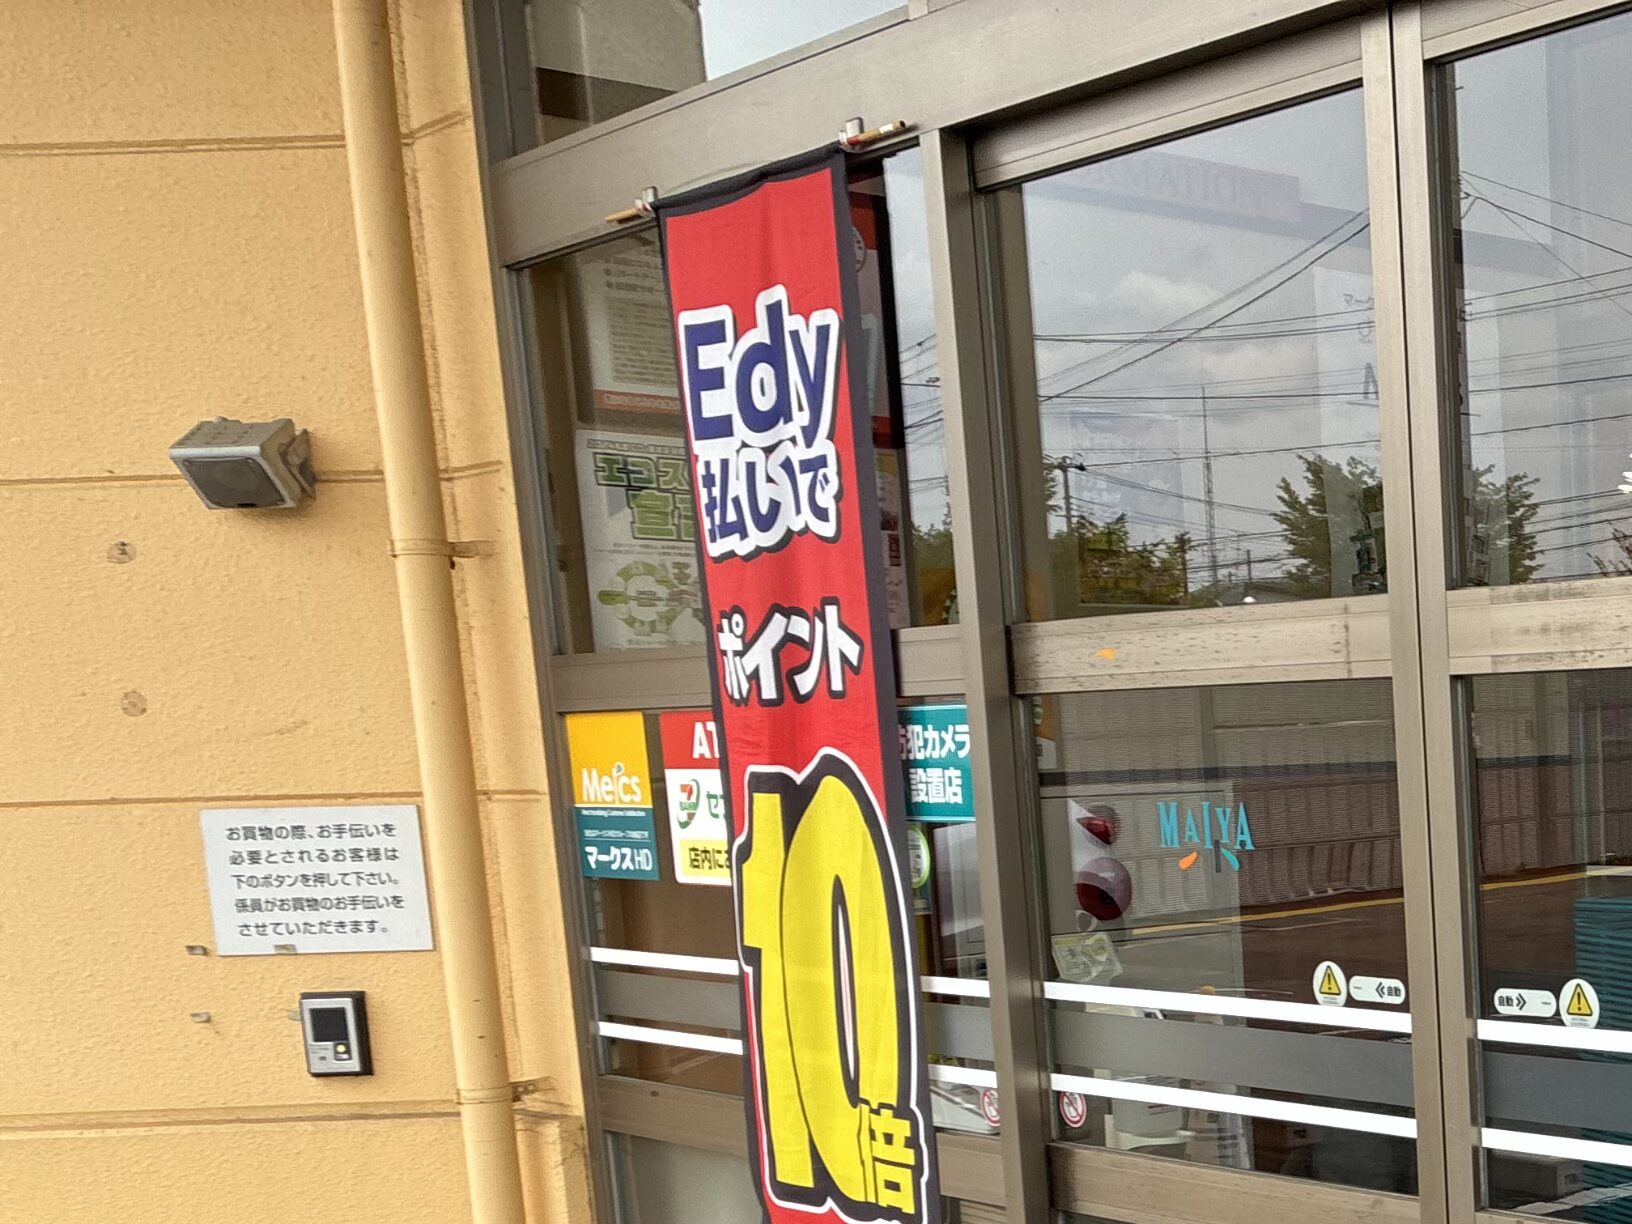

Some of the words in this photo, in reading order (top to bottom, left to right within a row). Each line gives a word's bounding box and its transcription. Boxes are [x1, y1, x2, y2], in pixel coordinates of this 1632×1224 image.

[683, 299, 832, 450] Edy
[702, 454, 831, 544] 払いで
[718, 604, 861, 701] ポイント
[909, 767, 963, 804] 設置店
[229, 847, 399, 866] 必要とされるお客様は
[585, 846, 653, 871] マークスHD
[231, 871, 399, 889] 下のボタンを押して下さい。
[238, 919, 389, 937] させていただきます。
